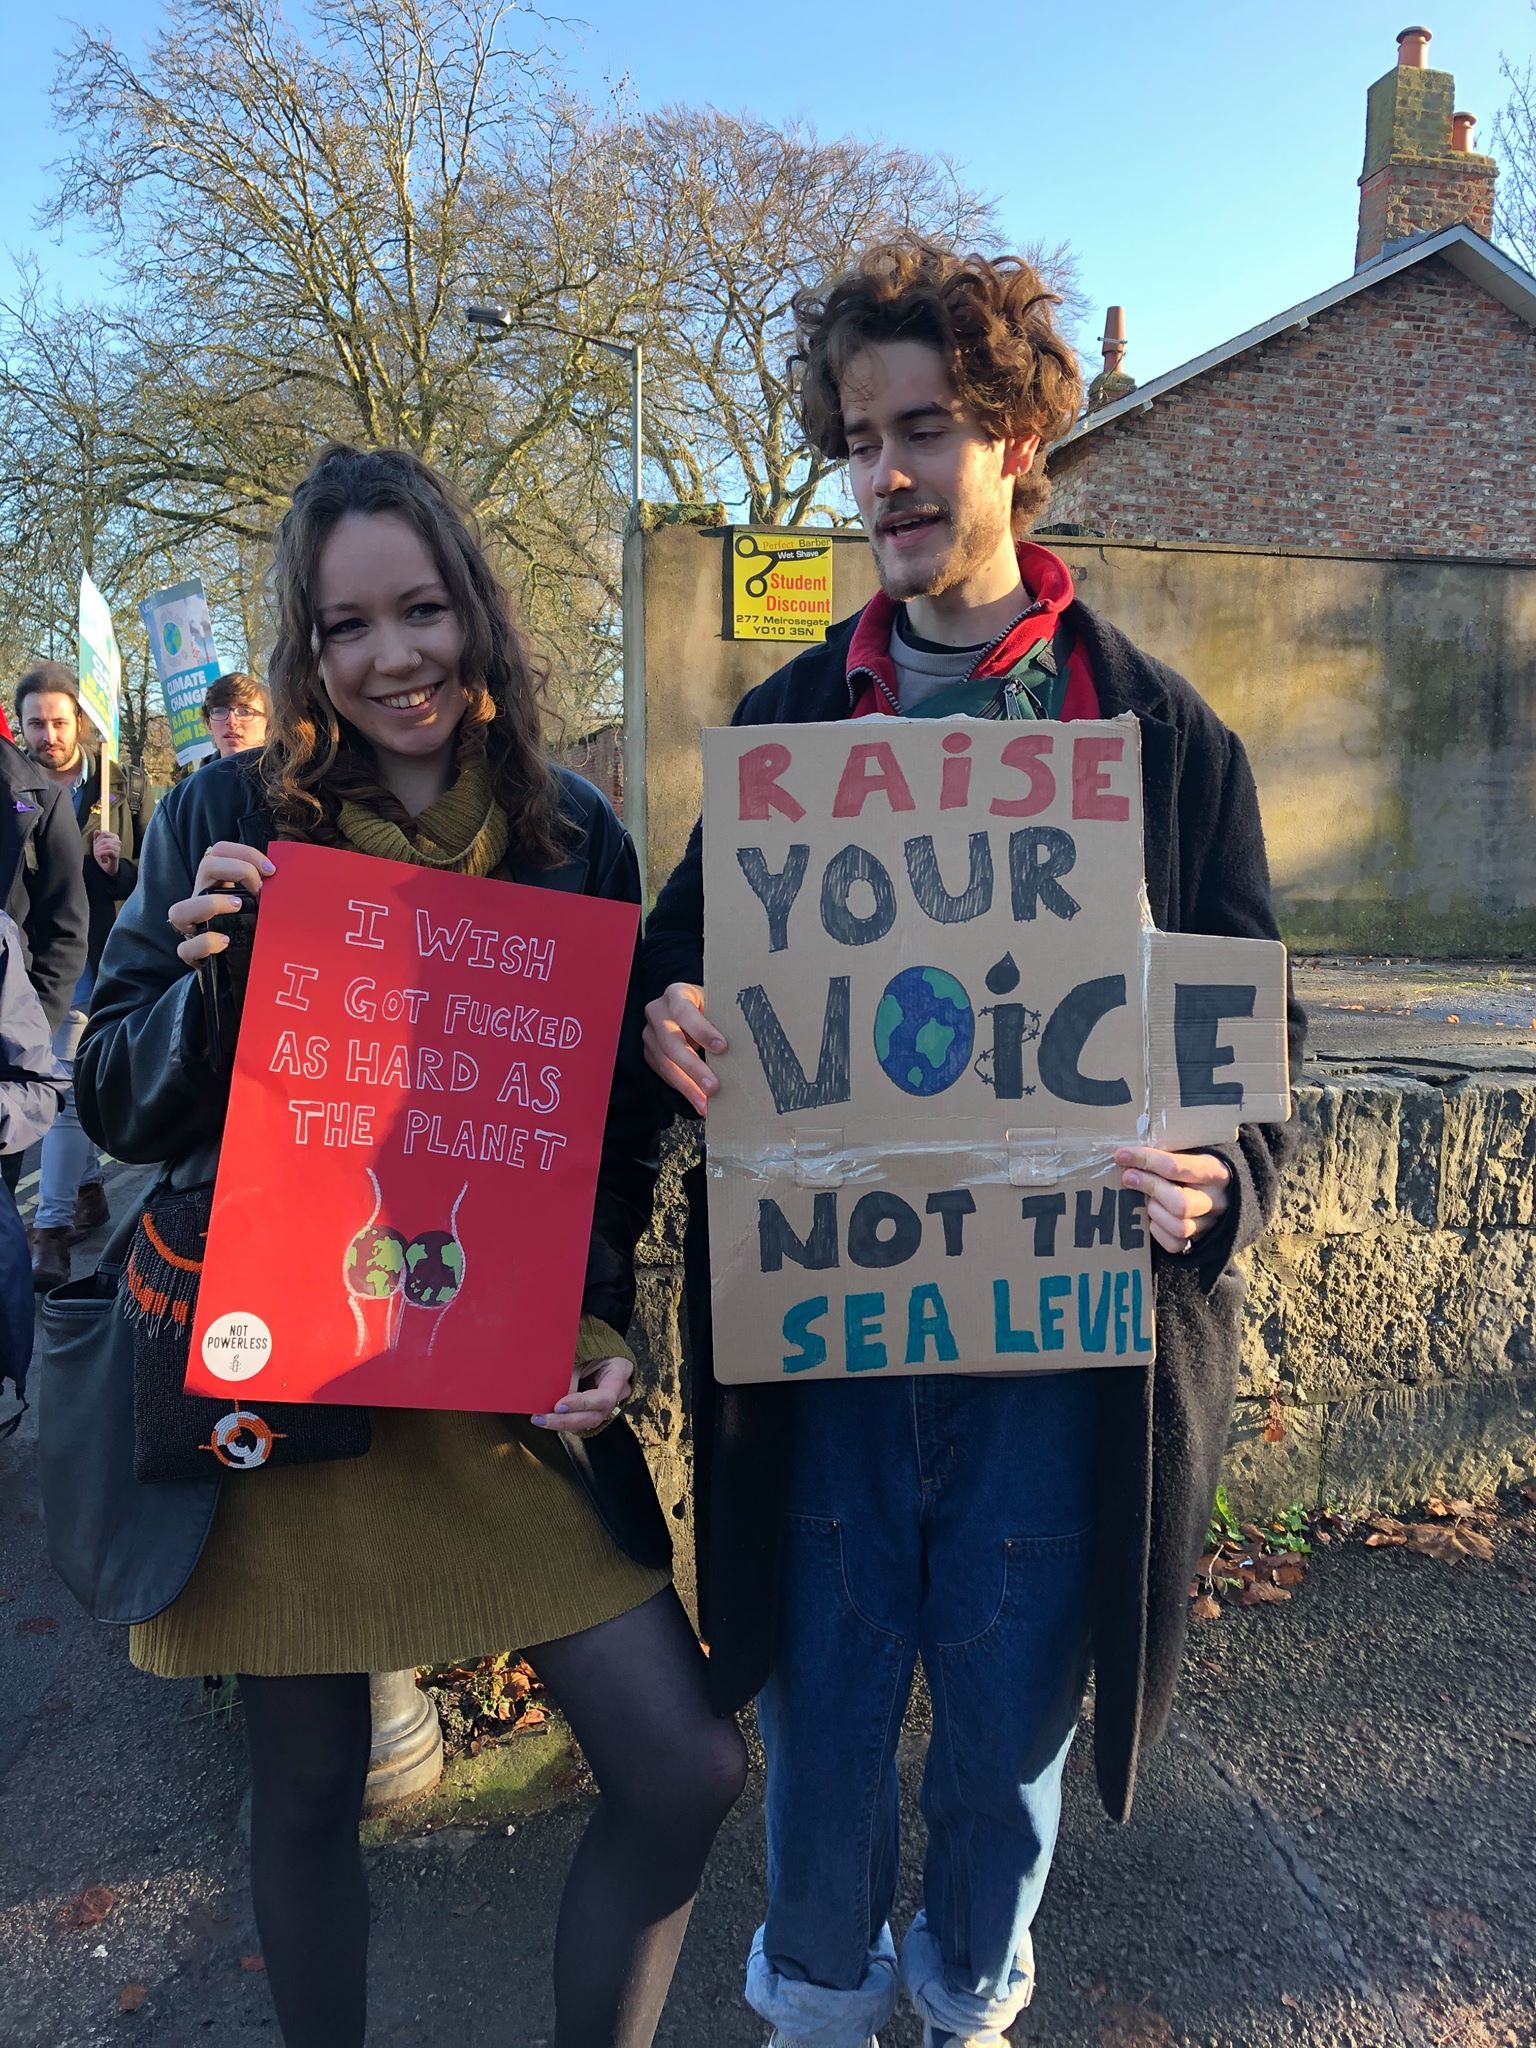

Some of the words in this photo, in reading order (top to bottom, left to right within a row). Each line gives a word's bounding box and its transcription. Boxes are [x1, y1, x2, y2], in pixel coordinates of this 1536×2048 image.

[762, 540, 794, 550] Perfect
[799, 538, 831, 548] Barber
[777, 551, 794, 559] Wet
[796, 550, 819, 558] Shave
[770, 572, 827, 591] Student
[766, 595, 830, 613] Discount
[736, 615, 759, 623] 277
[763, 616, 830, 627] Melrosegate
[753, 626, 785, 635] YO10
[790, 627, 814, 636] 3SN
[167, 670, 206, 696] CLIMATE
[736, 826, 1081, 953] YOUR
[345, 899, 389, 950] I
[415, 908, 556, 981] WISH
[275, 963, 319, 1012] I
[344, 976, 430, 1024] GOT
[443, 994, 583, 1050] FUCKED
[268, 1031, 331, 1079] AS
[346, 1039, 479, 1092] HARD
[496, 1061, 562, 1115] AS
[288, 1099, 375, 1148] THE
[403, 1109, 567, 1171] PLANET
[758, 1188, 977, 1274] NOT
[1021, 1188, 1146, 1258] THE
[229, 1324, 249, 1337] NOT
[782, 1282, 960, 1374] SEA
[993, 1269, 1152, 1355] LEVEL
[207, 1336, 268, 1350] POWERLESS
